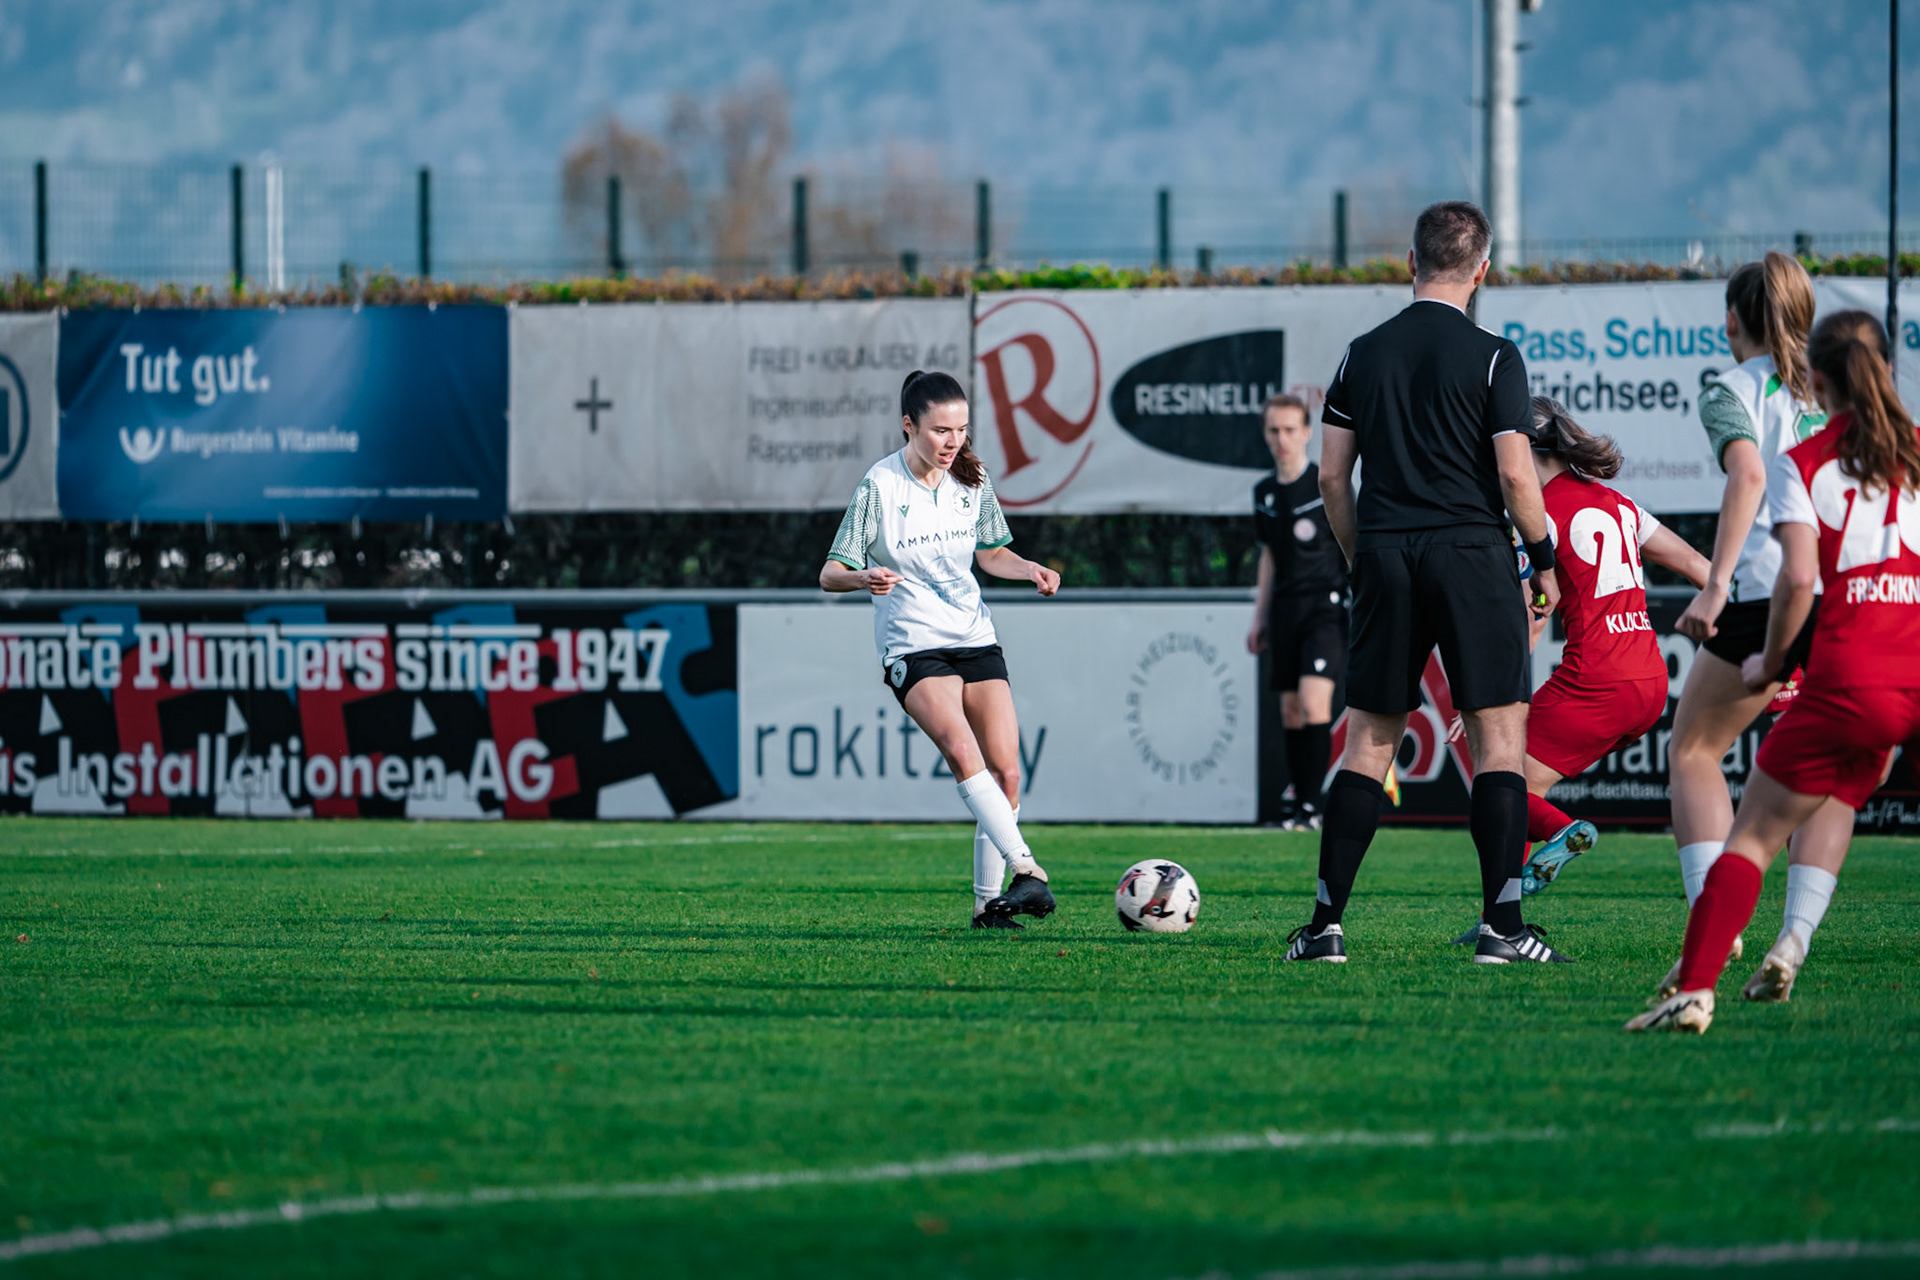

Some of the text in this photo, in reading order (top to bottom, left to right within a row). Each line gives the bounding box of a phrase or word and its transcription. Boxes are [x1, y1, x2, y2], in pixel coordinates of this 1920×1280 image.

[1503, 317, 1731, 363] Pass, Schuss
[120, 343, 270, 406] Tut gut.
[1530, 373, 1689, 415] ürichsee,
[278, 426, 359, 452] Vitamine
[896, 532, 942, 549] AMMA
[133, 624, 388, 690] Plumbers
[396, 624, 542, 691] since
[552, 628, 671, 691] 1947
[58, 733, 447, 799] Installationen
[466, 738, 554, 801] AG
[756, 705, 1047, 795] rokity
